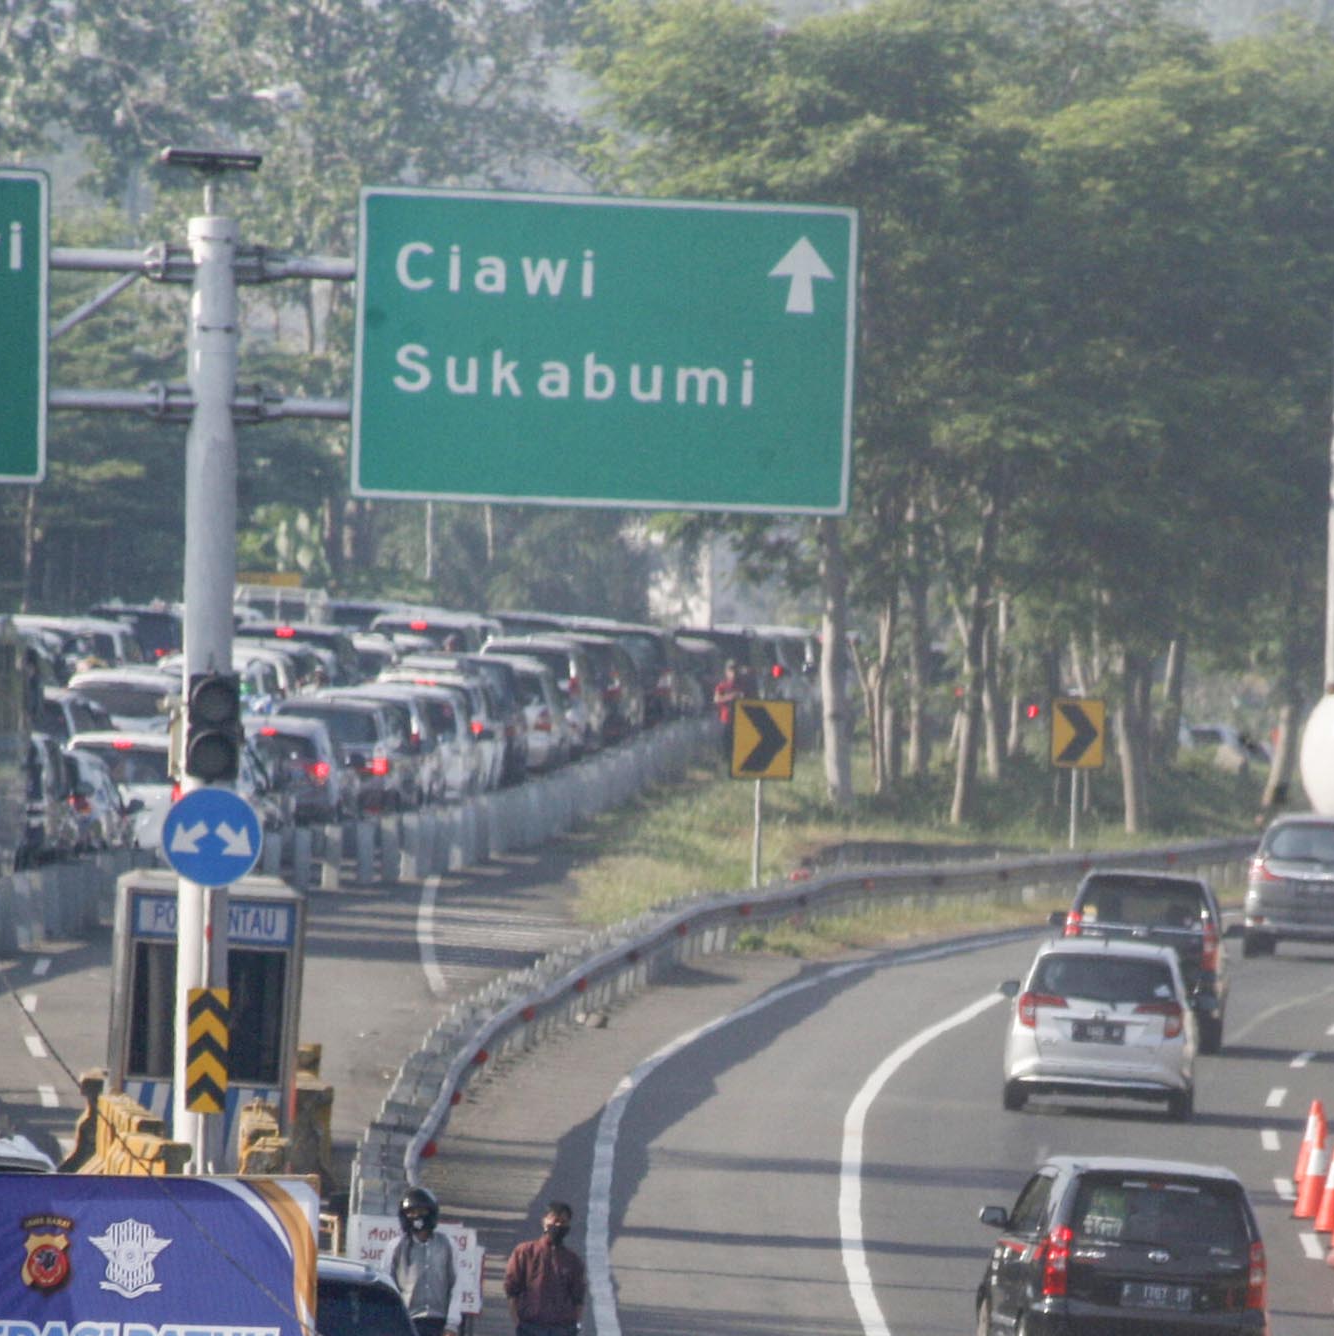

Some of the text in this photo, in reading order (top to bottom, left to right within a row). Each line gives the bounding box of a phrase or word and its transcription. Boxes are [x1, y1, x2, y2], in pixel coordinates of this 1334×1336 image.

[395, 241, 596, 298] Ciawi
[393, 343, 754, 407] Sukabumi
[154, 904, 178, 929] PO
